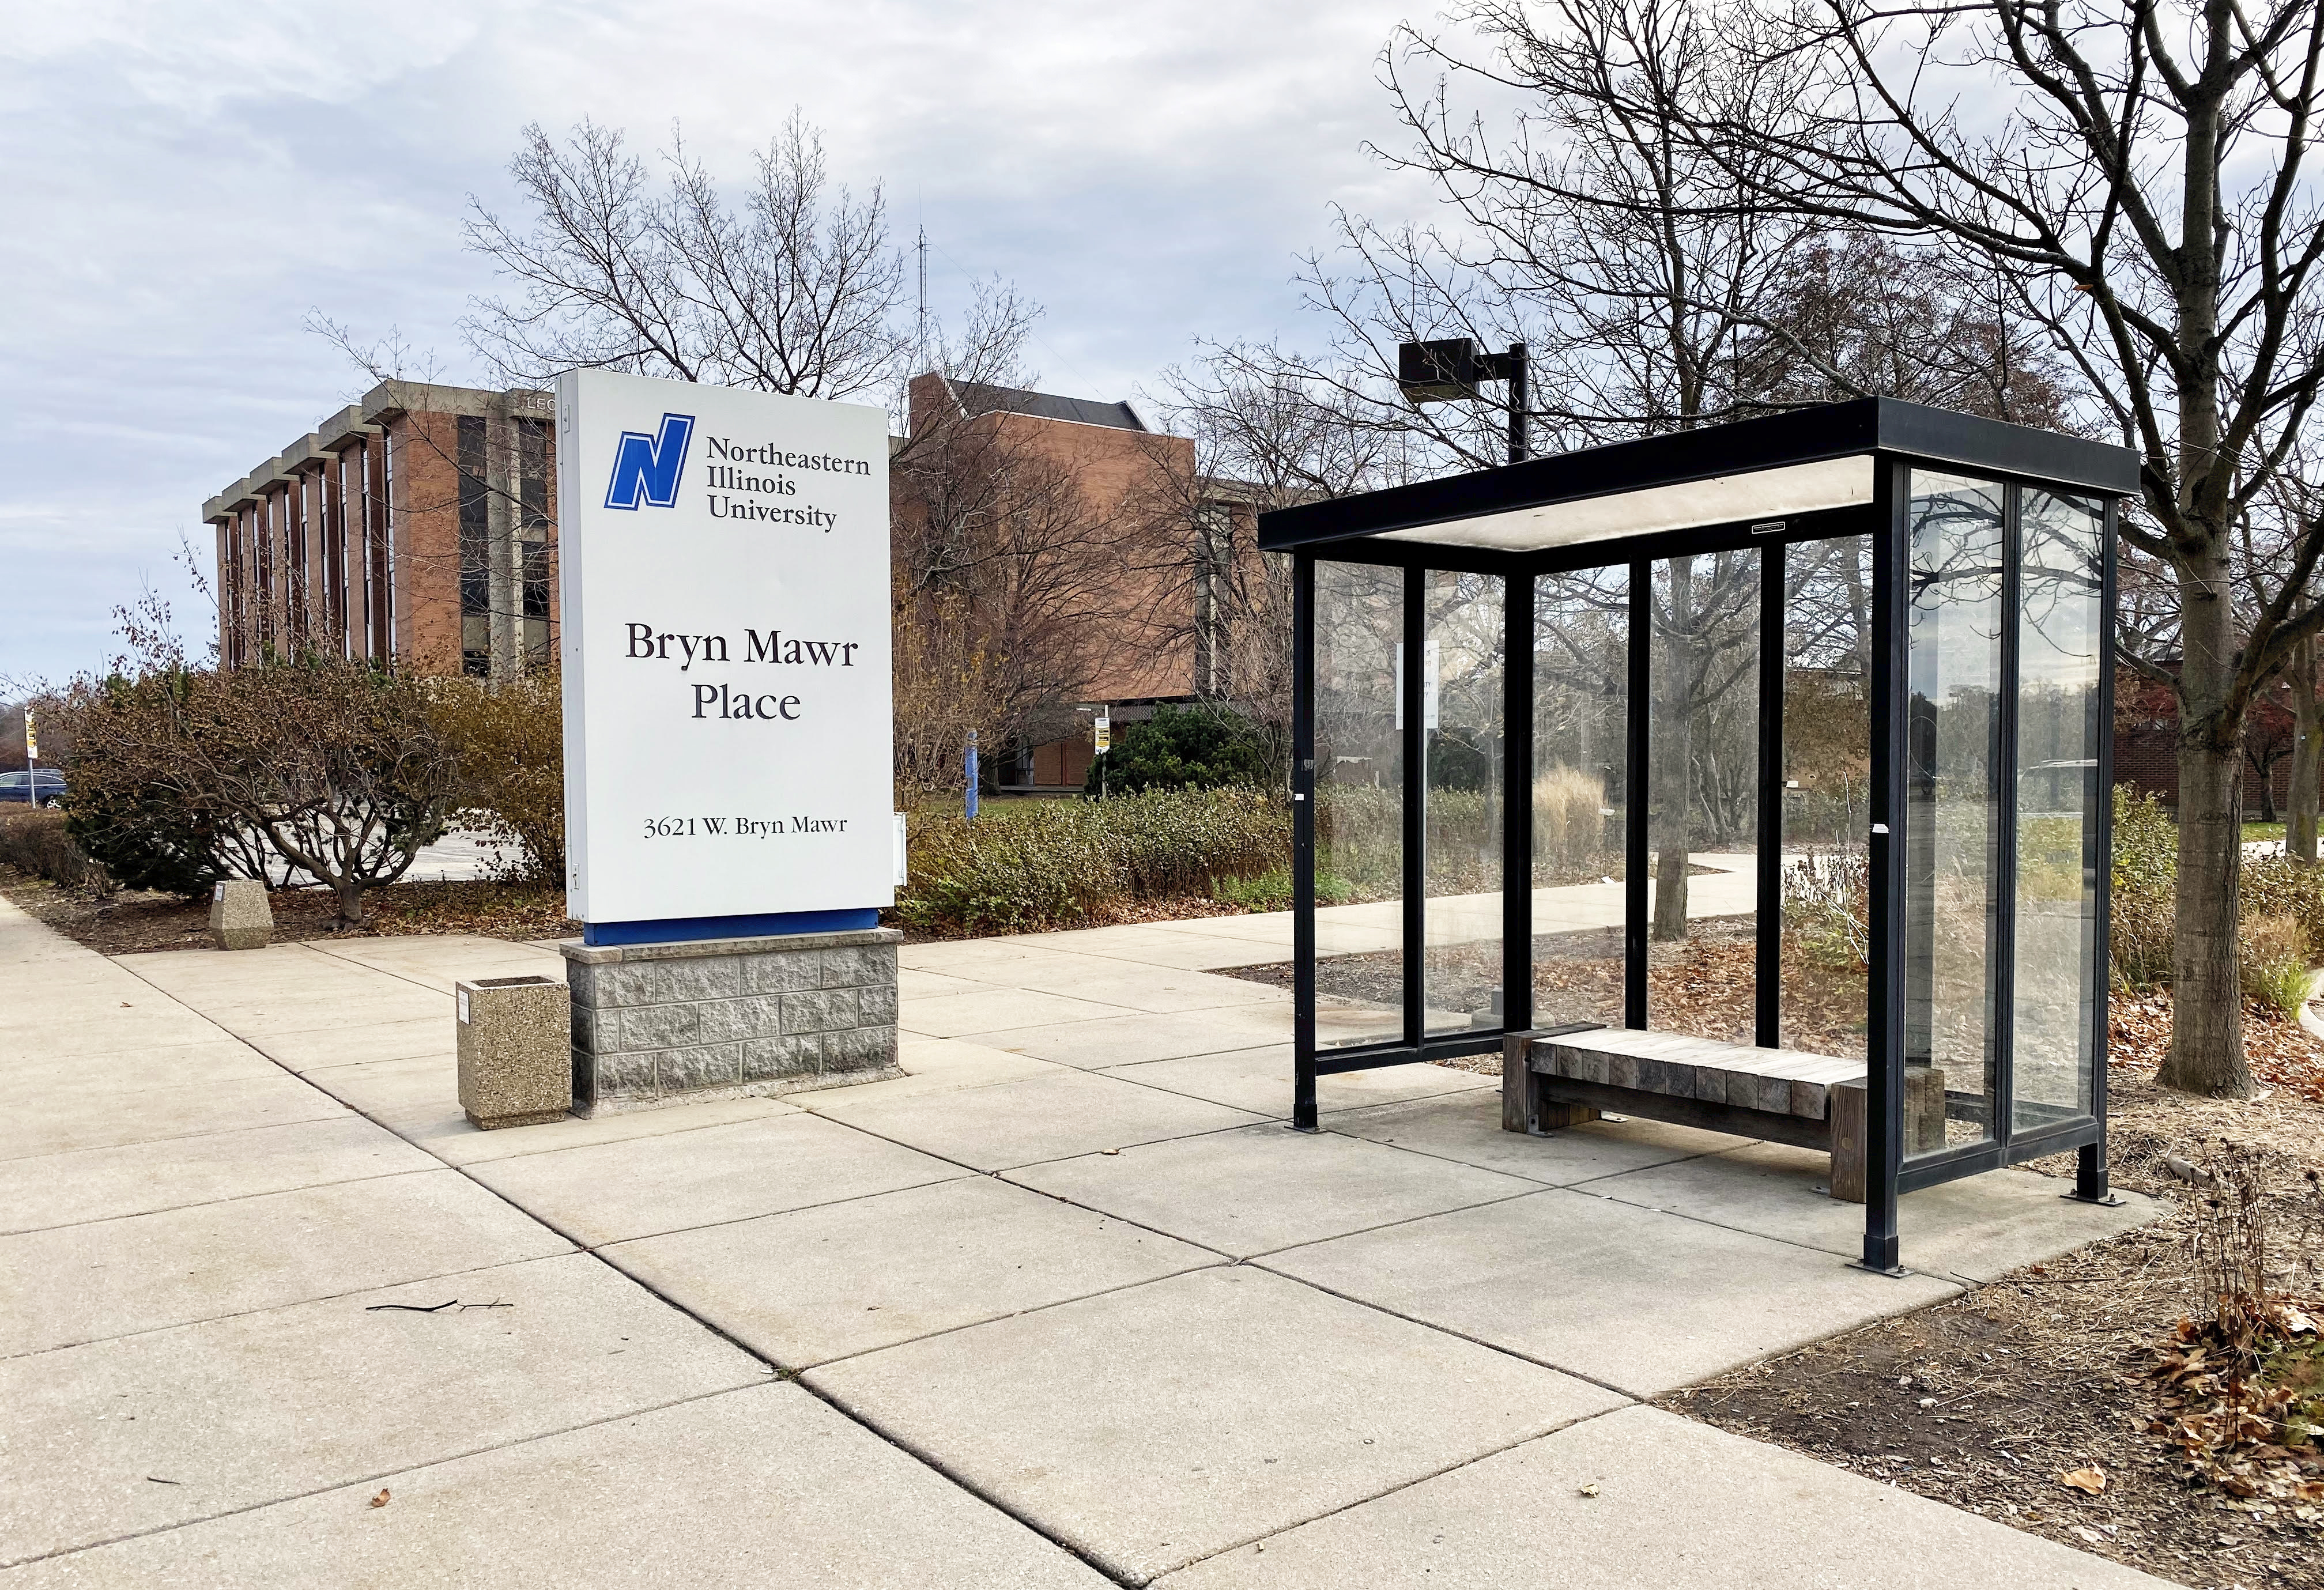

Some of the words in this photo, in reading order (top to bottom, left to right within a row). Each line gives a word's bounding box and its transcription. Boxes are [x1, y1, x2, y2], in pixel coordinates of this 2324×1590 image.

[706, 436, 871, 476] Northeastern
[706, 465, 796, 496] Illinois
[707, 494, 837, 534] University
[624, 623, 730, 671] Bryn
[743, 629, 858, 667] Mawr
[691, 683, 801, 720] Place
[644, 816, 696, 839] 3621
[701, 817, 727, 836] W.
[735, 817, 785, 839] Bryn
[791, 816, 847, 833] Mawr
